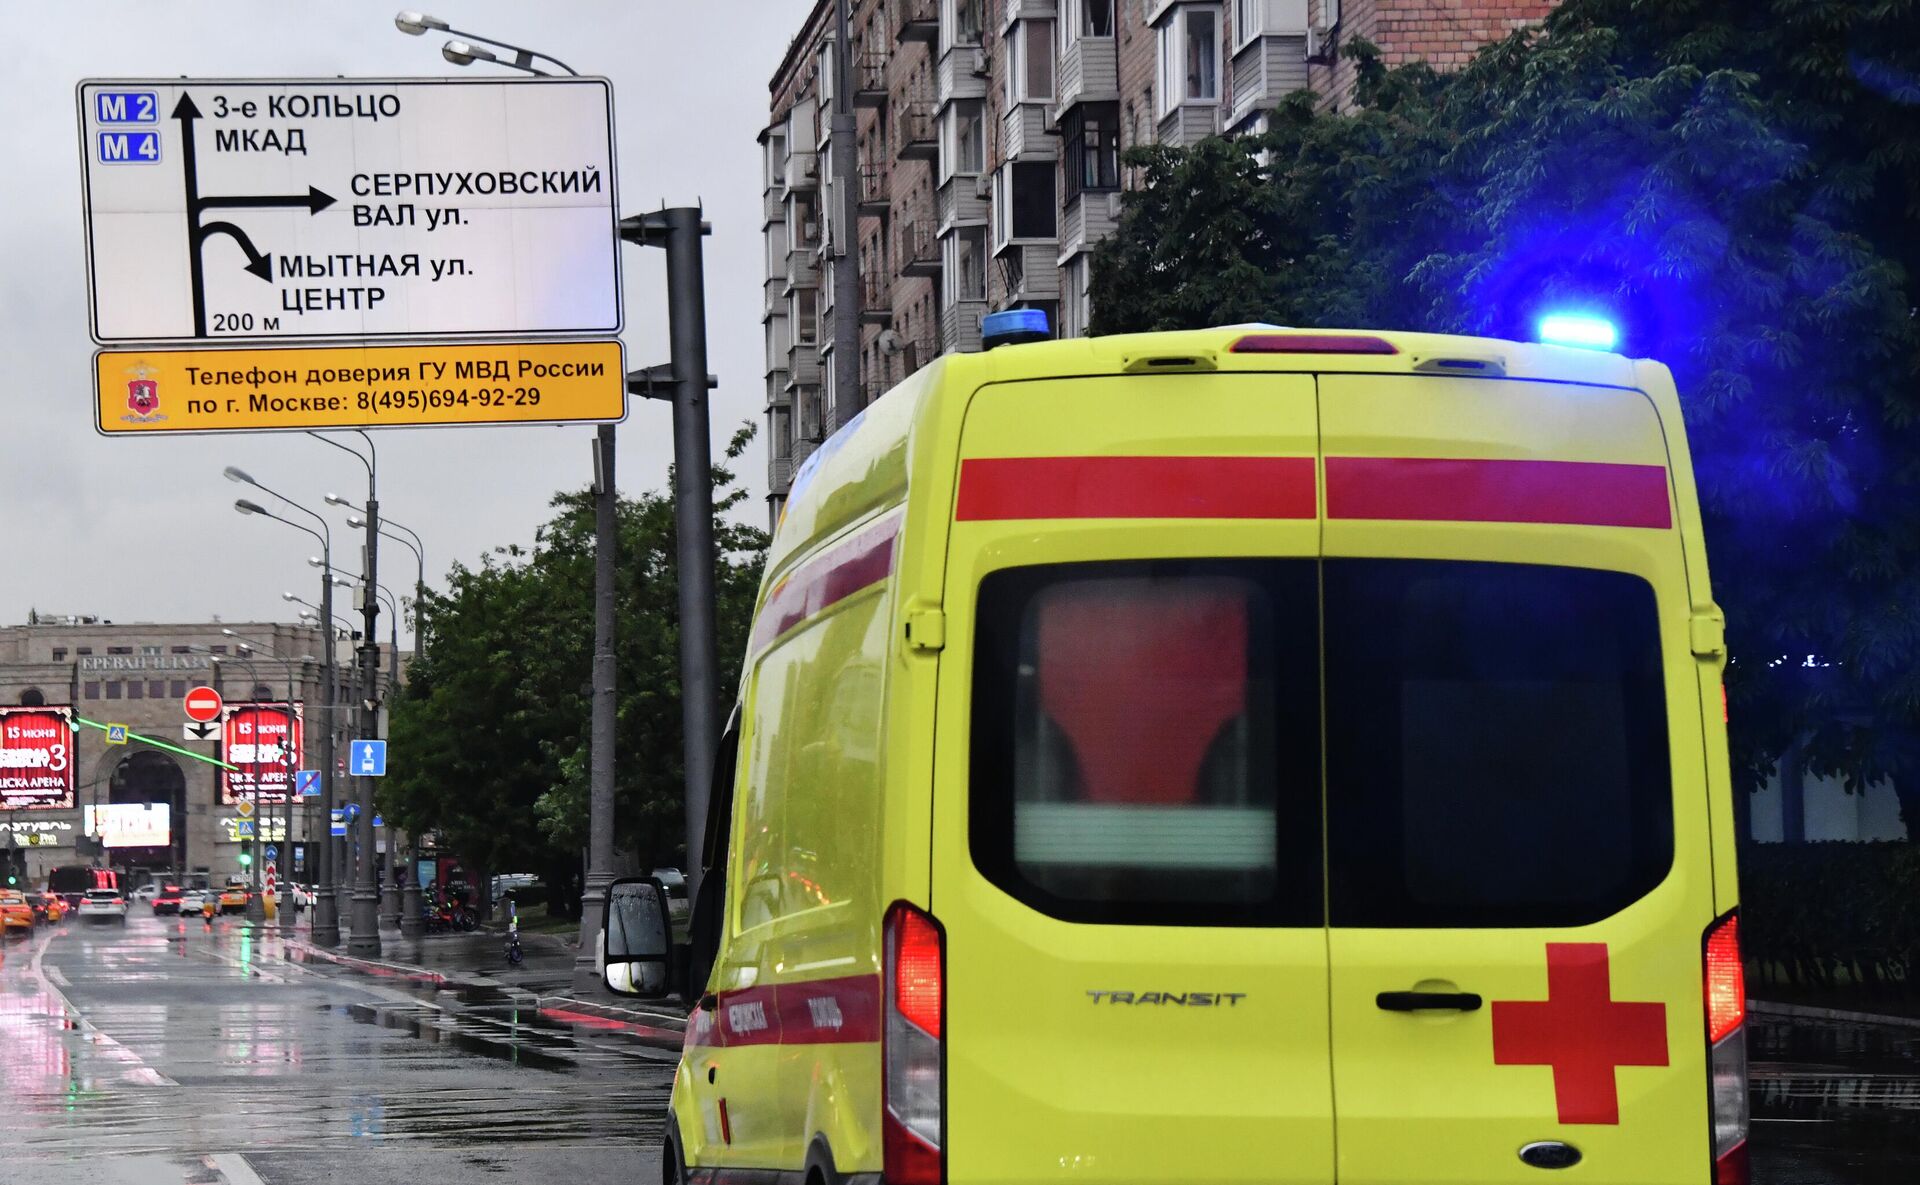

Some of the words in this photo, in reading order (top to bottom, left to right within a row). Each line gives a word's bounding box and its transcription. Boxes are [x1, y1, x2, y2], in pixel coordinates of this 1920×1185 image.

[136, 94, 156, 120] 2
[213, 95, 257, 119] 3-е
[268, 94, 401, 122] КОЛЬЦО
[138, 134, 157, 159] 4
[215, 129, 307, 156] МКАД
[350, 165, 602, 197] СЕРПУХОВСКИЙ
[352, 203, 415, 227] ВАЛ
[425, 208, 469, 232] ул.
[279, 253, 420, 278] МЫТНАЯ
[430, 259, 473, 282] ул.
[281, 287, 385, 316] ЦЕНТР
[213, 313, 254, 332] 200
[263, 317, 280, 331] м
[185, 365, 297, 389] Телефон
[304, 366, 411, 387] доверия
[418, 361, 447, 382] ГУ
[455, 360, 511, 383] МВД
[517, 359, 605, 379] России
[187, 399, 218, 414] по
[226, 398, 240, 413] г.
[248, 393, 348, 414] Москве:
[357, 388, 541, 411] 8(495)694-92-29
[82, 656, 146, 670] ЕРЕВАН
[7, 726, 20, 739] 15
[238, 722, 253, 735] 15
[30, 777, 65, 788] АРЕНА
[1086, 990, 1247, 1007] TRANSIT
